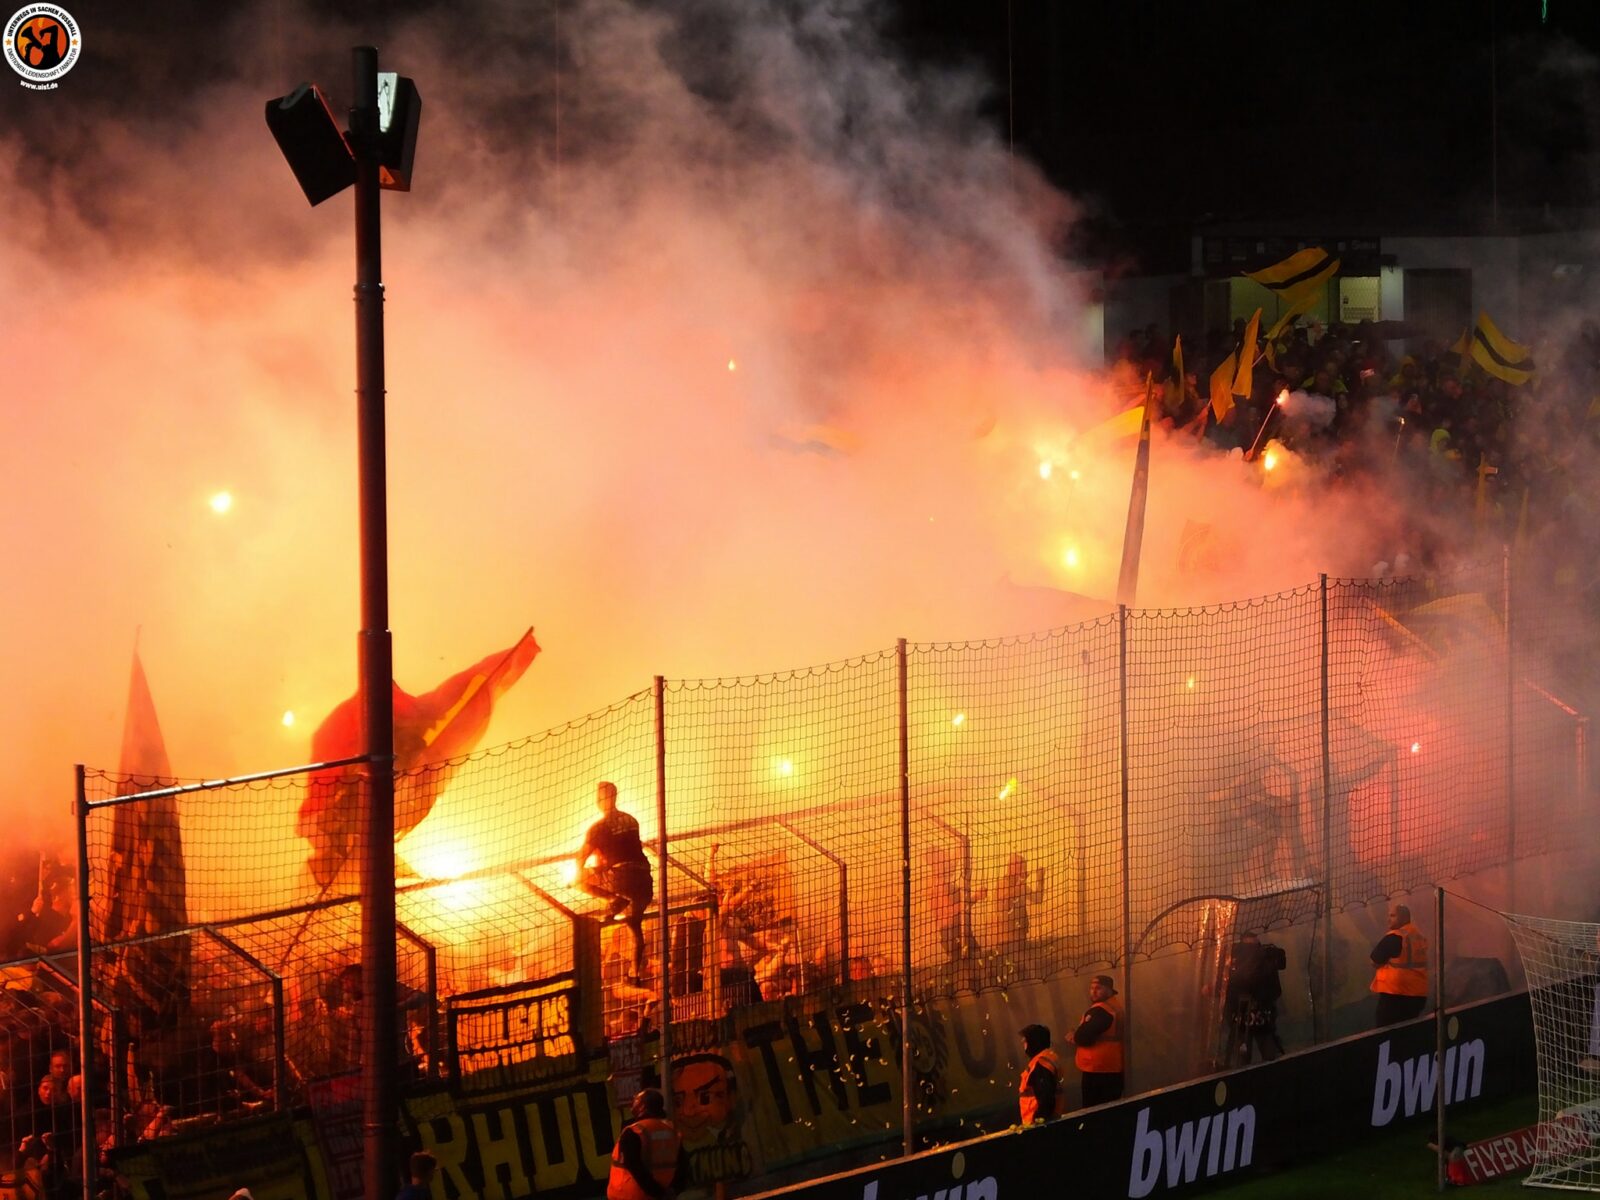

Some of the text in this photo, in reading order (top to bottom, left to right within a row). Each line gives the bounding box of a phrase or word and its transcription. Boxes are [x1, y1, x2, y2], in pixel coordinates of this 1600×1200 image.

[744, 1003, 892, 1125] THE
[1371, 1015, 1485, 1128] bwin
[1128, 1081, 1256, 1199] bwin
